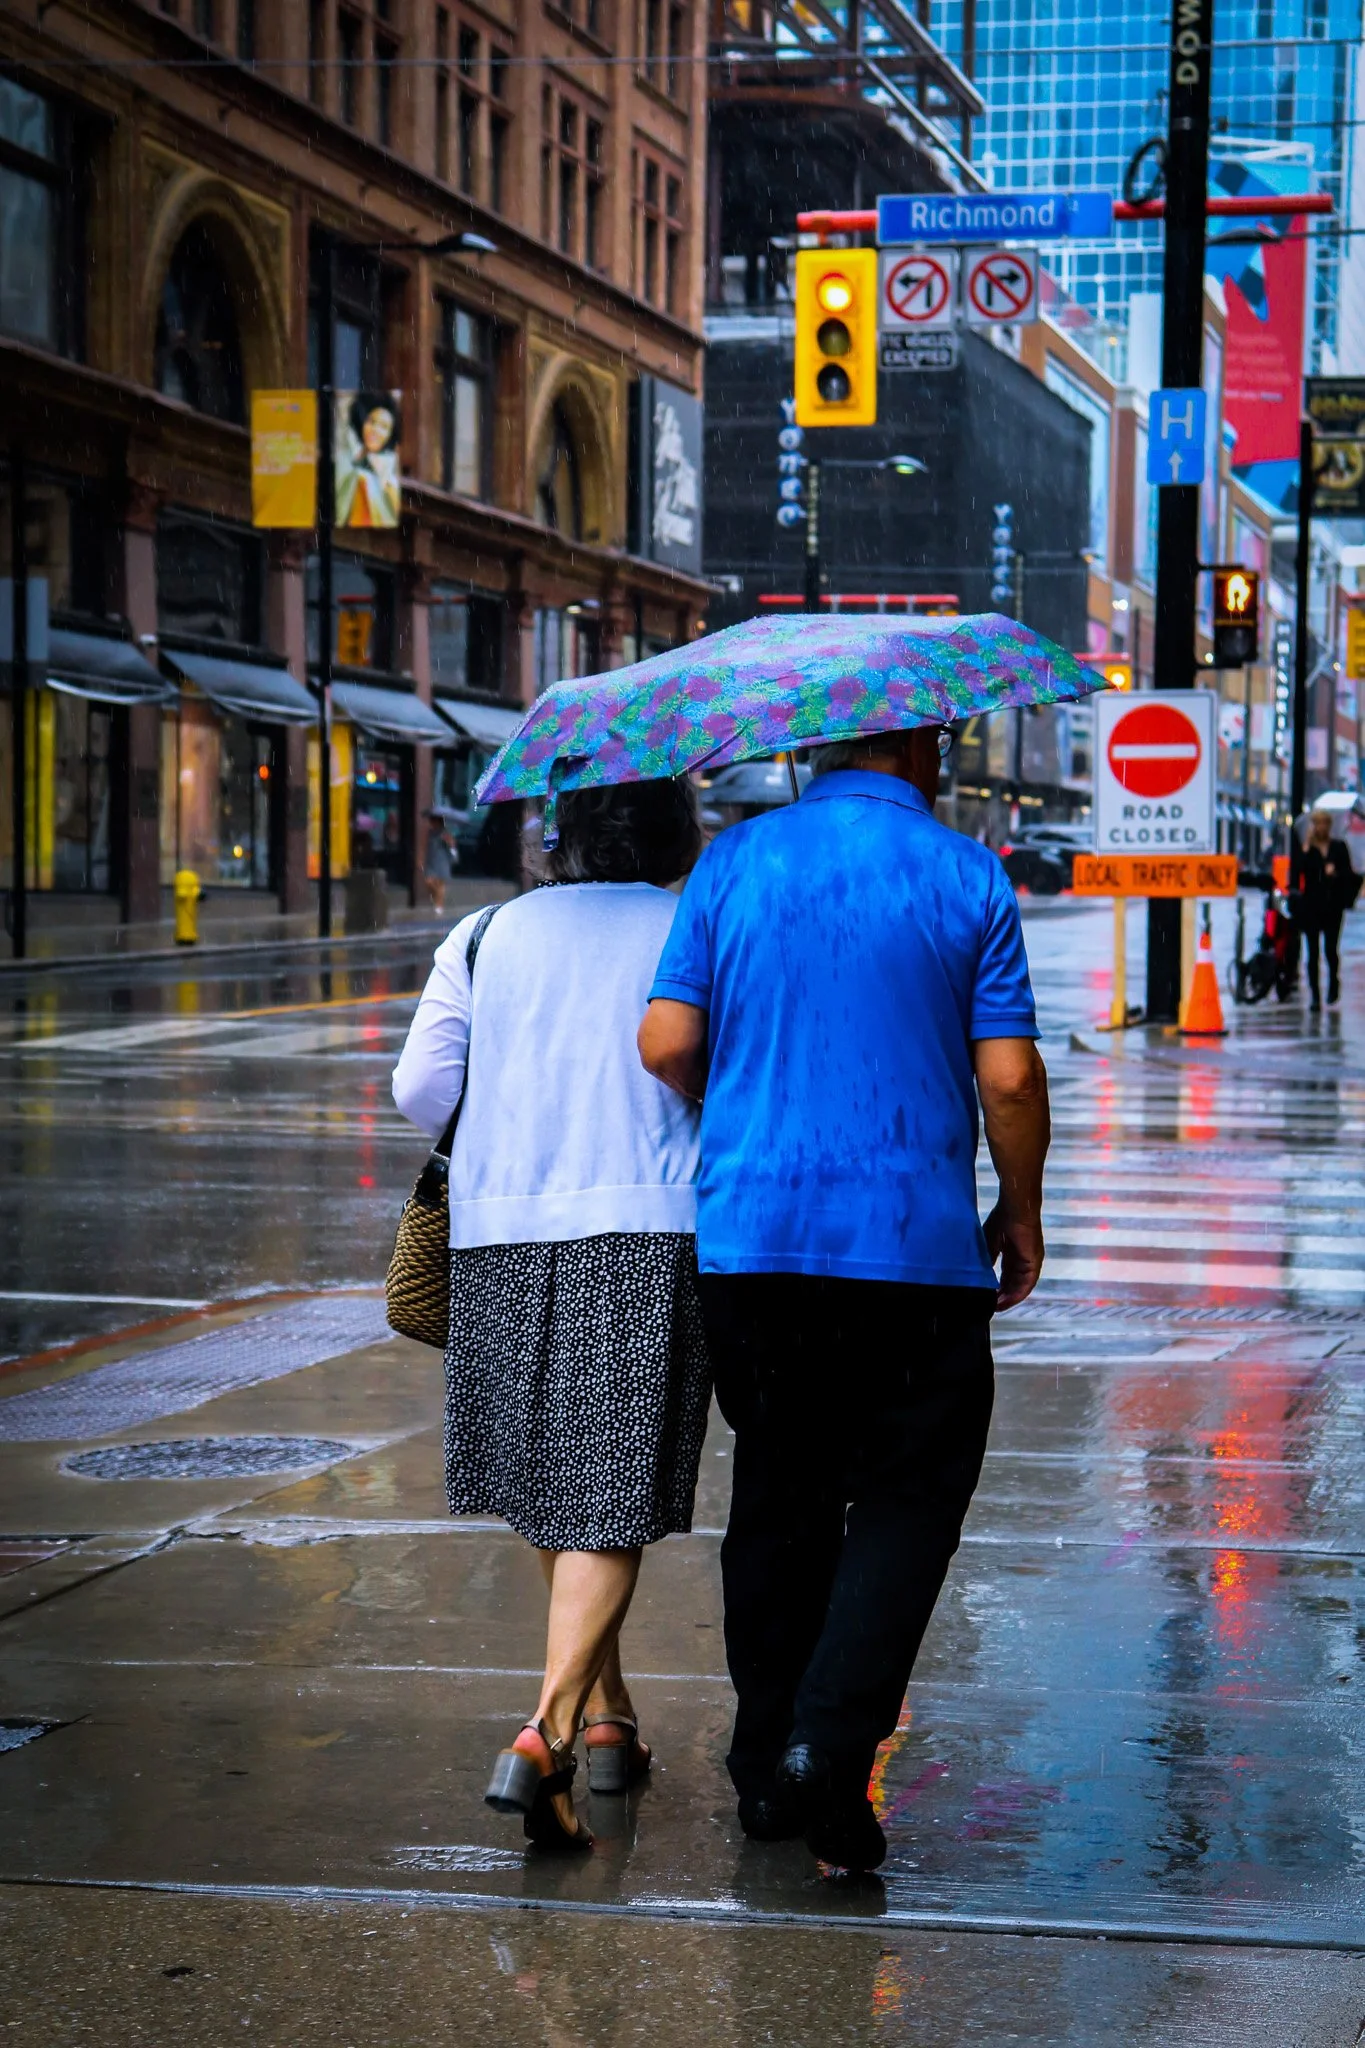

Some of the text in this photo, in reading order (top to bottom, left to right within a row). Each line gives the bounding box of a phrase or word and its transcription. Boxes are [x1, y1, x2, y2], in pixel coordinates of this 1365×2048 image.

[911, 199, 1055, 229] Richmond
[1161, 399, 1193, 440] H
[1122, 805, 1184, 820] ROAD
[1108, 828, 1197, 844] CLOSED
[1077, 863, 1234, 889] LOCAL TRAFFIC ONLY
